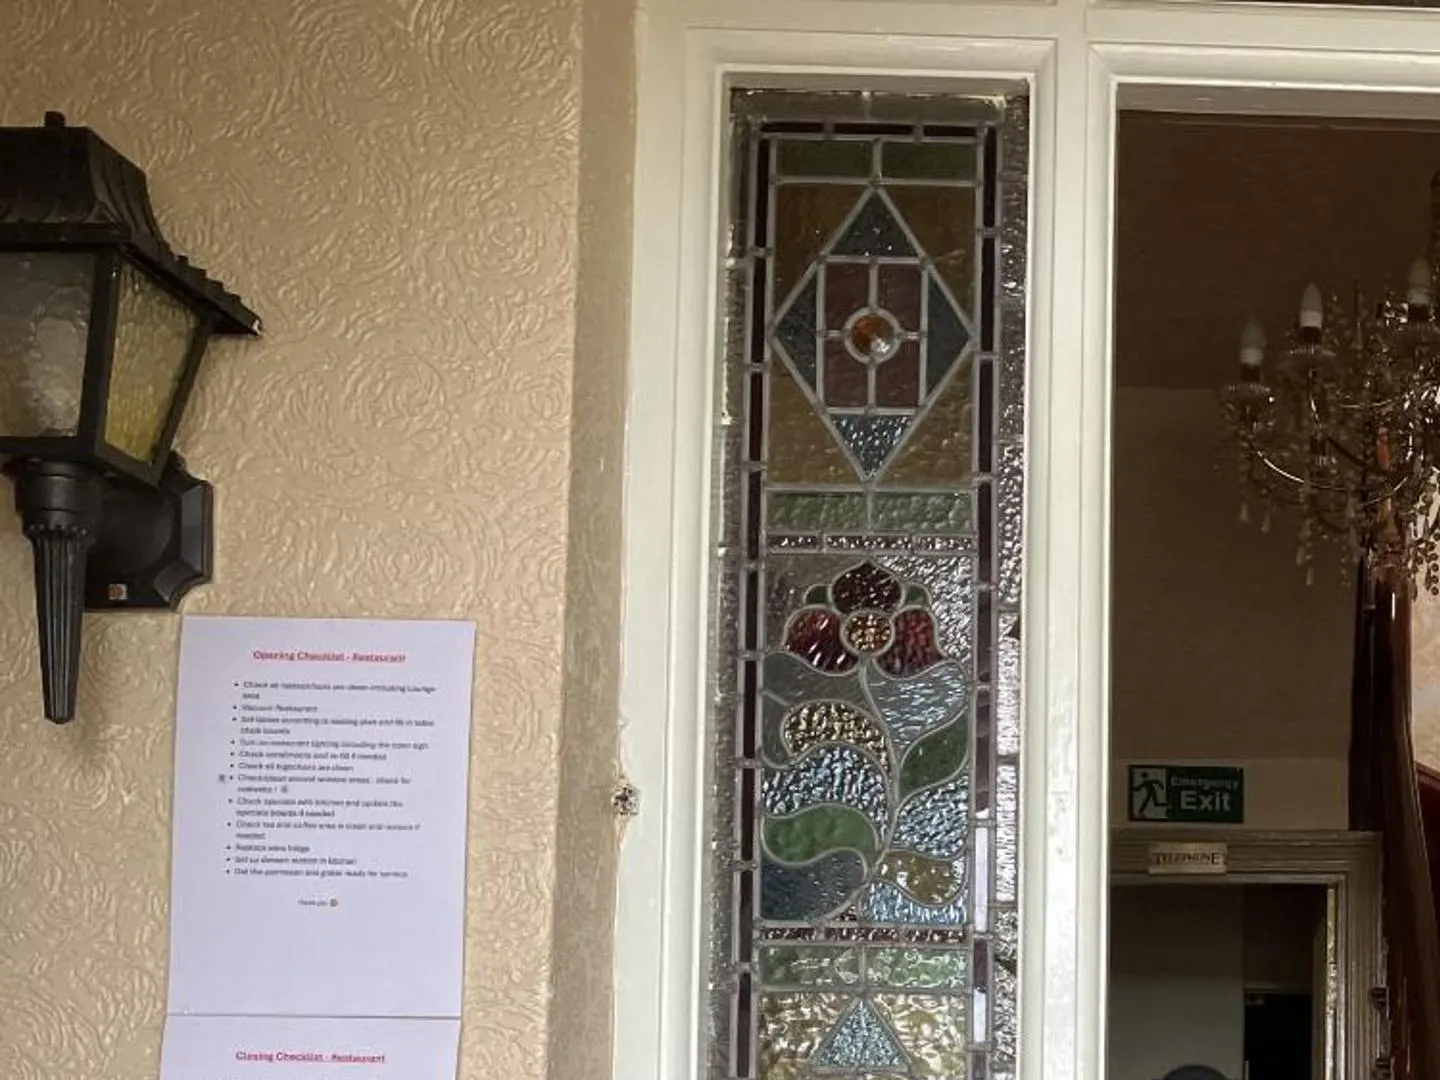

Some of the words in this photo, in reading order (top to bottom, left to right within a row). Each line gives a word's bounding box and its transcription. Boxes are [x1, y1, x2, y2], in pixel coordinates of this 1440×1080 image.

[253, 650, 294, 661] Opening
[297, 651, 344, 661] Checklist
[353, 653, 406, 663] Restaurant
[1180, 790, 1230, 812] Exit
[235, 1051, 274, 1063] Closing
[276, 1051, 323, 1062] Checklist
[332, 1053, 386, 1065] Restaurant
